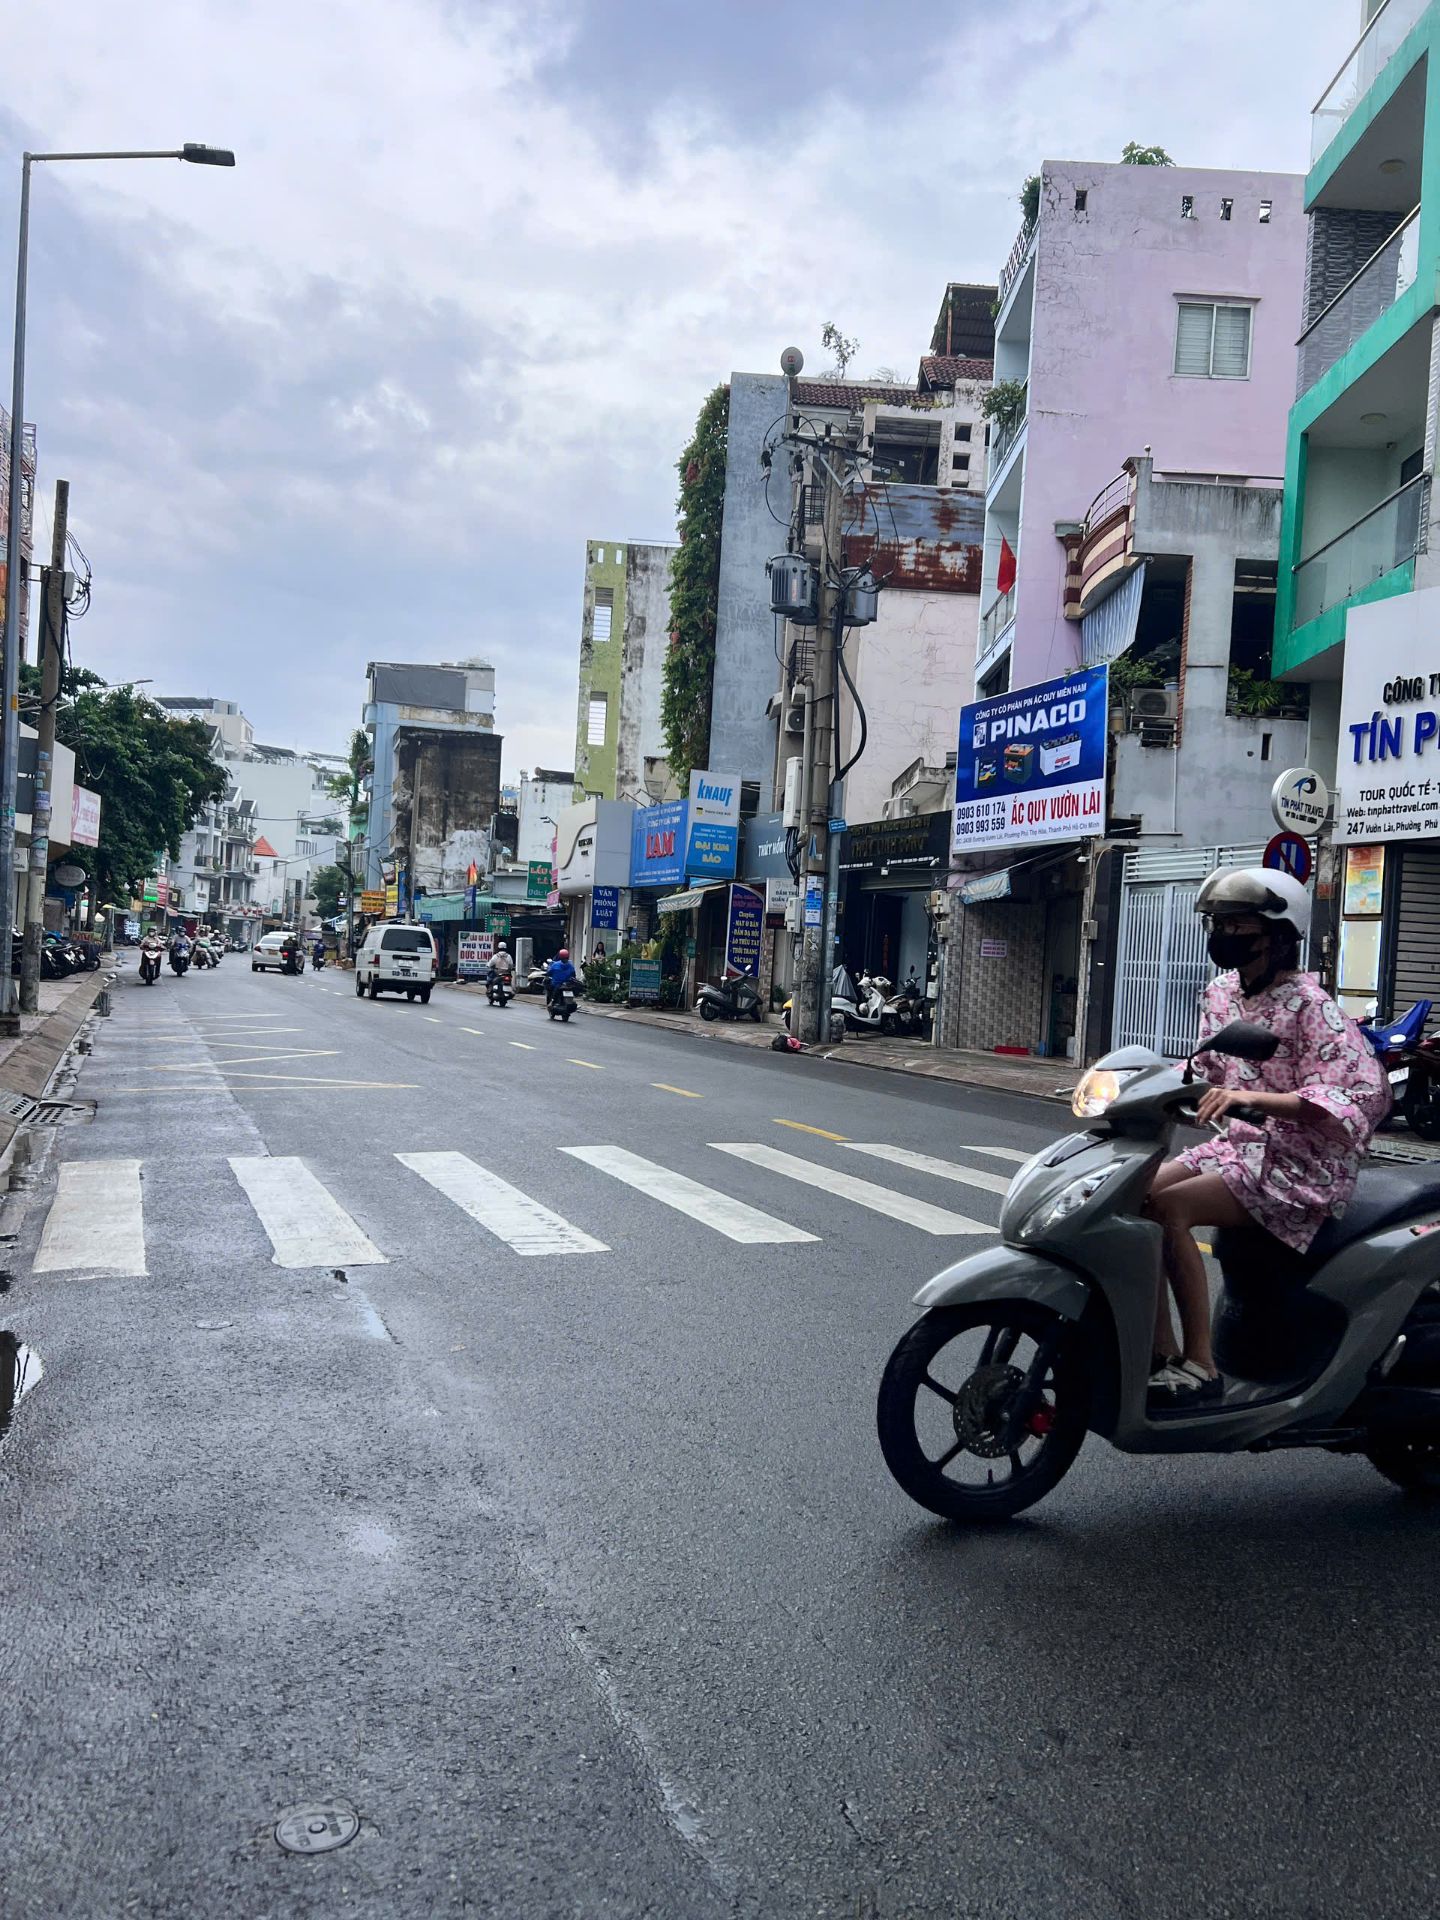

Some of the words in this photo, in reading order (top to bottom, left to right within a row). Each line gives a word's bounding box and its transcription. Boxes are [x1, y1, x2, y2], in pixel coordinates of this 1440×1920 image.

[1383, 676, 1425, 705] CÔNG
[975, 709, 990, 720] CÔNG
[991, 707, 999, 716] TY
[1024, 697, 1033, 707] PIN
[1042, 691, 1056, 702] QUY
[1072, 682, 1087, 694] NAM
[991, 699, 1086, 742] PINACO
[1349, 711, 1403, 764] TÍN
[1360, 788, 1386, 802] TOUR
[1388, 780, 1416, 800] QUỐC
[1418, 778, 1430, 796] TẾ
[957, 806, 974, 820] 0903
[976, 804, 990, 817] 610
[992, 802, 1006, 814] 174
[1010, 796, 1024, 825] ẮC
[1028, 799, 1048, 825] QUY
[1050, 790, 1080, 820] VƯỜN
[1304, 804, 1324, 818] TRAVEL
[1347, 806, 1366, 818] Web:
[1368, 801, 1438, 818] tinphattravel.com
[956, 820, 974, 836] 0903
[976, 818, 990, 832] 993
[991, 816, 1006, 830] 559
[1347, 822, 1364, 835] 247
[599, 889, 612, 897] VĂN
[594, 899, 616, 907] PHÒNG
[596, 909, 614, 917] LUẬT
